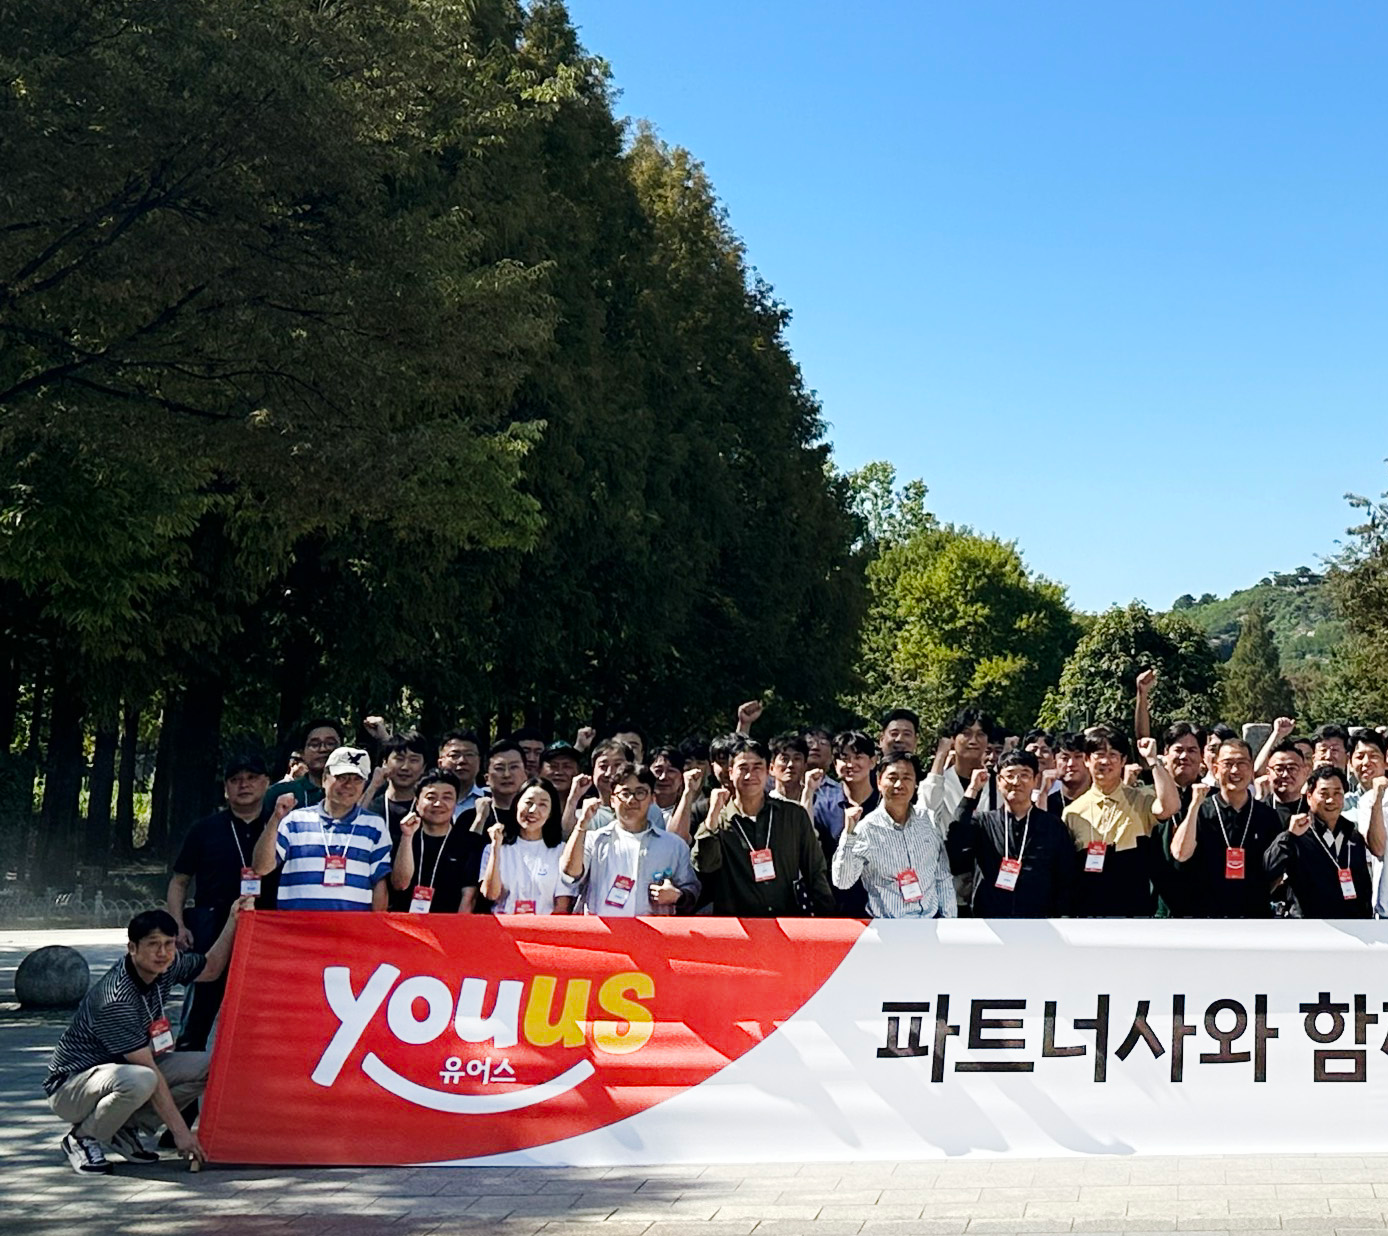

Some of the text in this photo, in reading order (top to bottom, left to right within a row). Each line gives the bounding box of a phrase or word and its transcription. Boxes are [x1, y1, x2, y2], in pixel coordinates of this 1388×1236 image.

[311, 963, 655, 1087] youus
[876, 993, 1280, 1083] 파트너사와
[439, 1056, 517, 1085] 유어스
